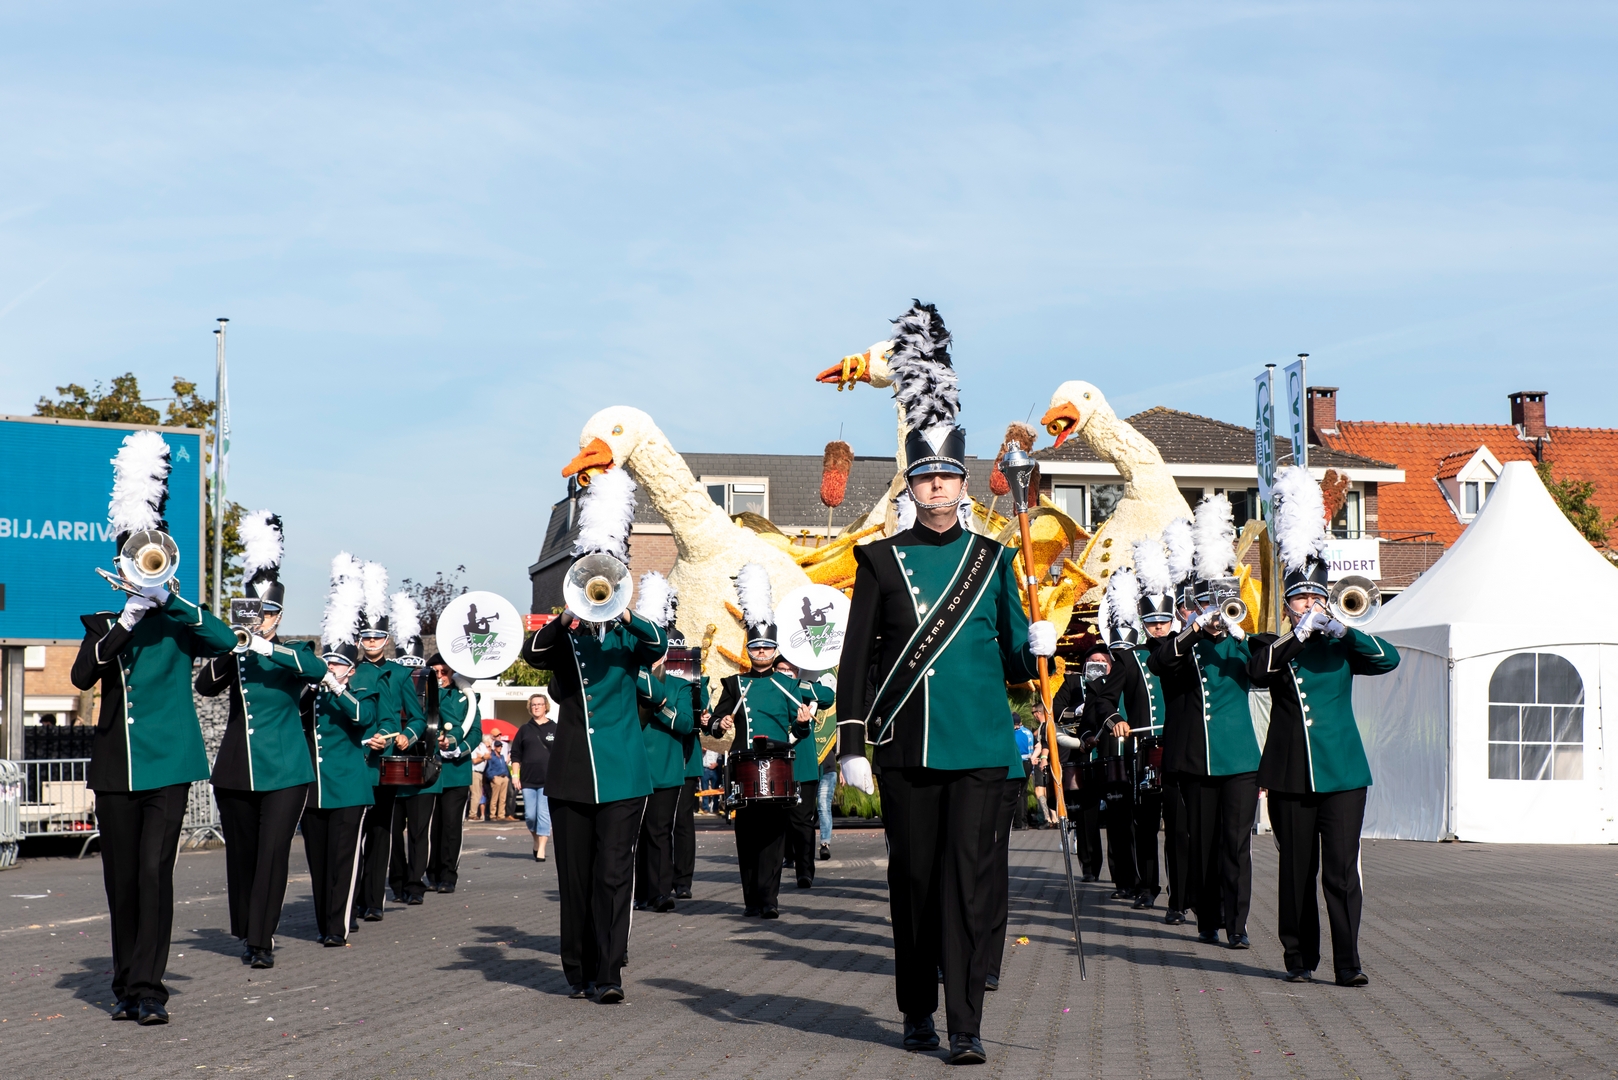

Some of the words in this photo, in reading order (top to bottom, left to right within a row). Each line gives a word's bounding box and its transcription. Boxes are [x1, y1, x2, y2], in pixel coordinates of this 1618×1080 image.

[0, 517, 117, 542] BIJ.ARRIV
[947, 548, 987, 612] EXCELSIOR
[450, 634, 507, 654] Excelsior
[908, 618, 945, 669] RENKUM
[758, 759, 771, 796] Dynasty
